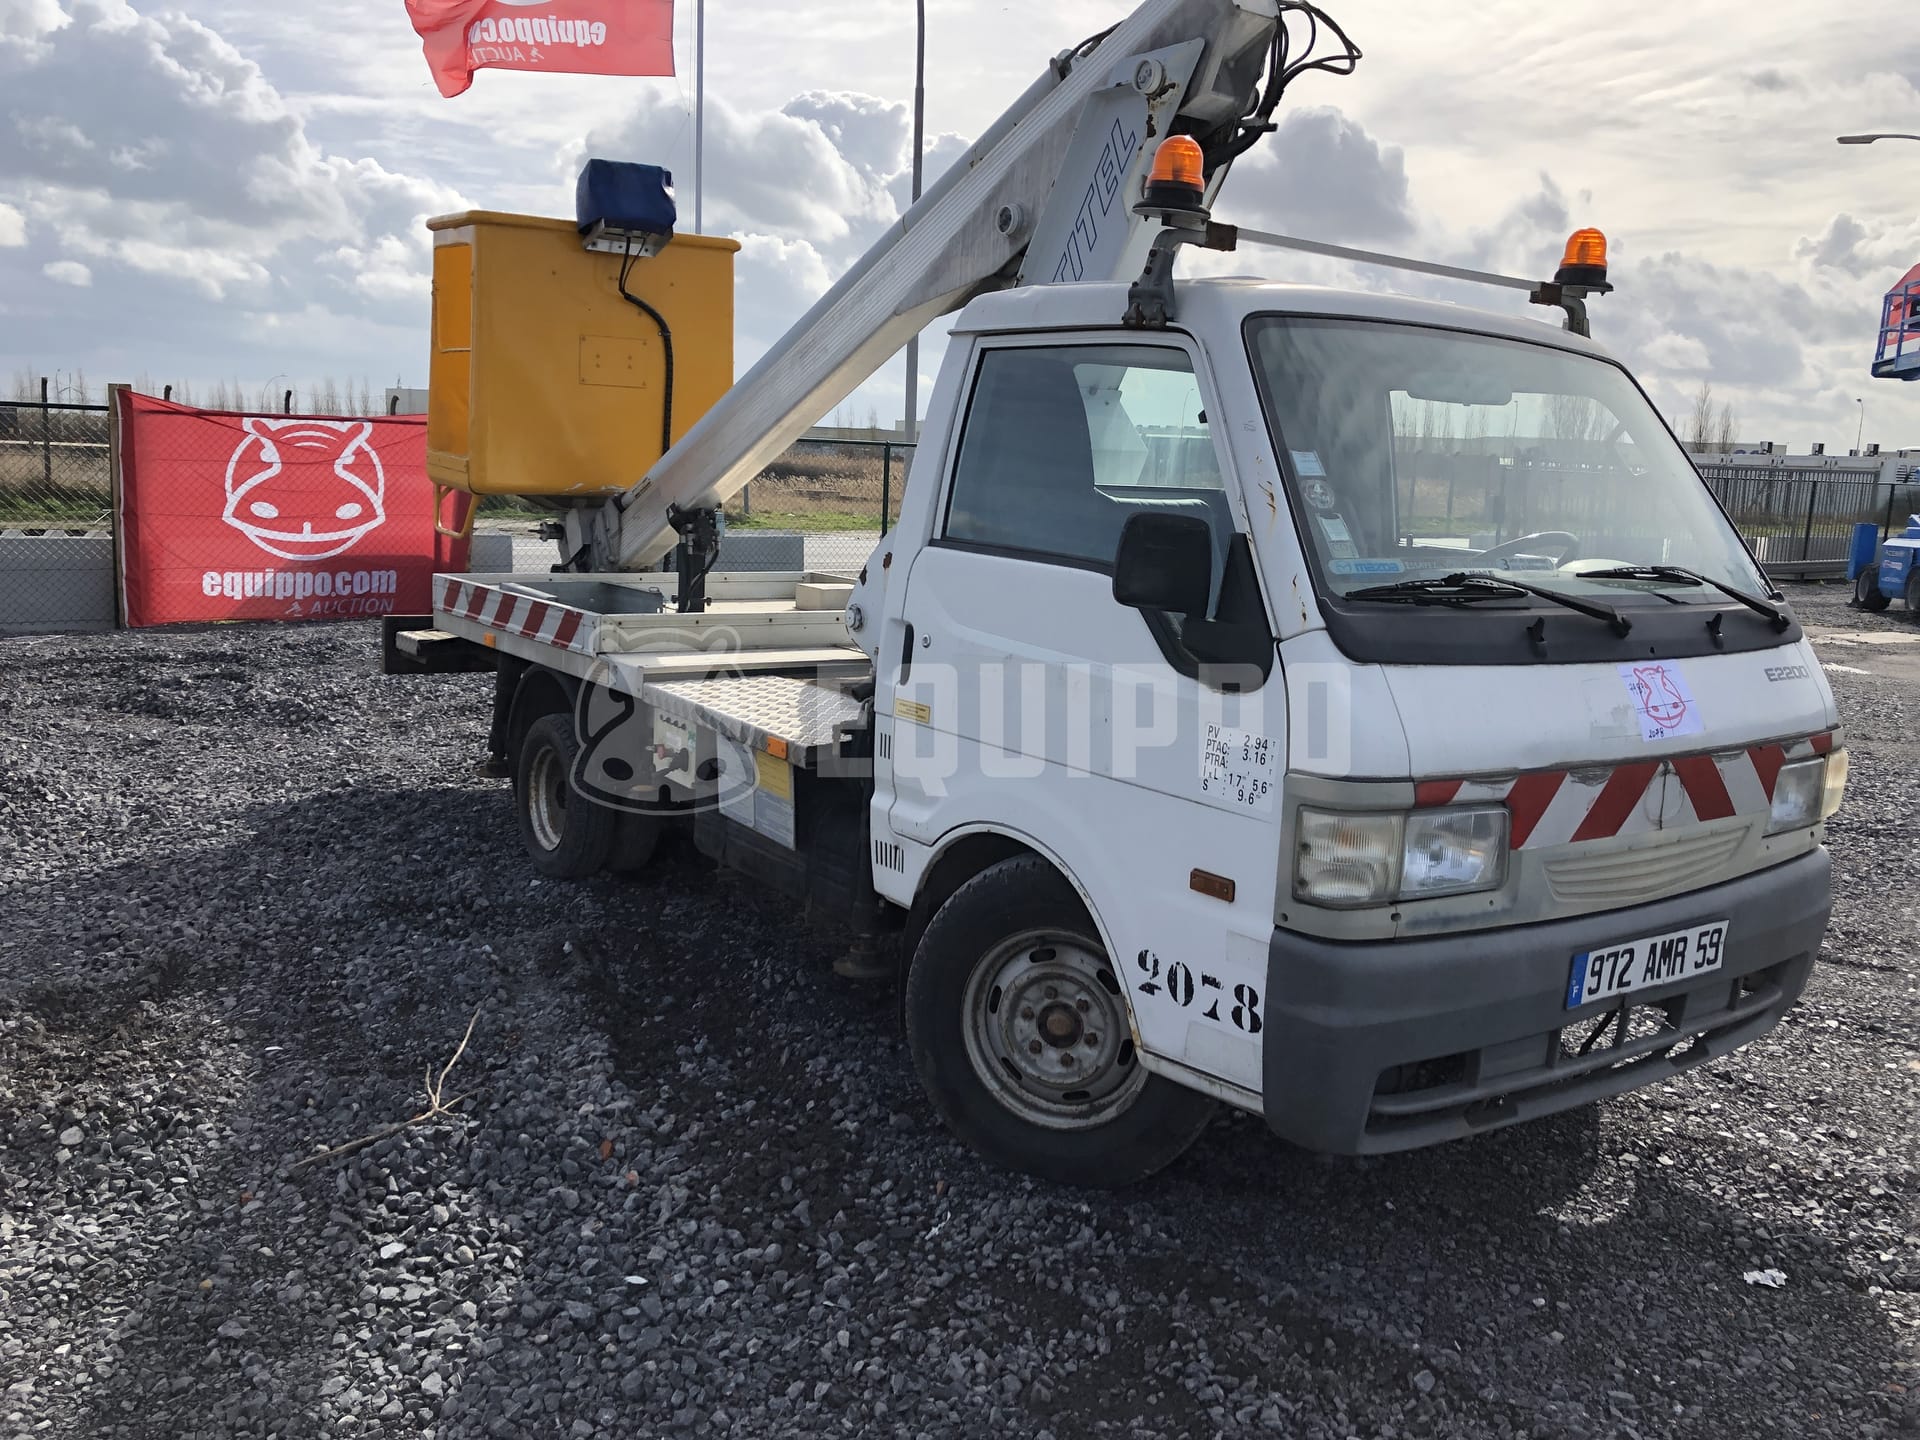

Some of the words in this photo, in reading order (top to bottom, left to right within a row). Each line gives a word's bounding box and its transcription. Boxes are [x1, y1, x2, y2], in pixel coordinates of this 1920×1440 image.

[202, 568, 397, 601] equippo.com
[310, 597, 395, 615] AUCTION
[1764, 665, 1810, 683] E2200
[1202, 779, 1209, 791] S
[1587, 947, 1636, 996] 972
[1642, 936, 1689, 983] AMR
[1693, 927, 1724, 970] 59
[1137, 949, 1263, 1034] 2078
[1572, 985, 1580, 999] F
